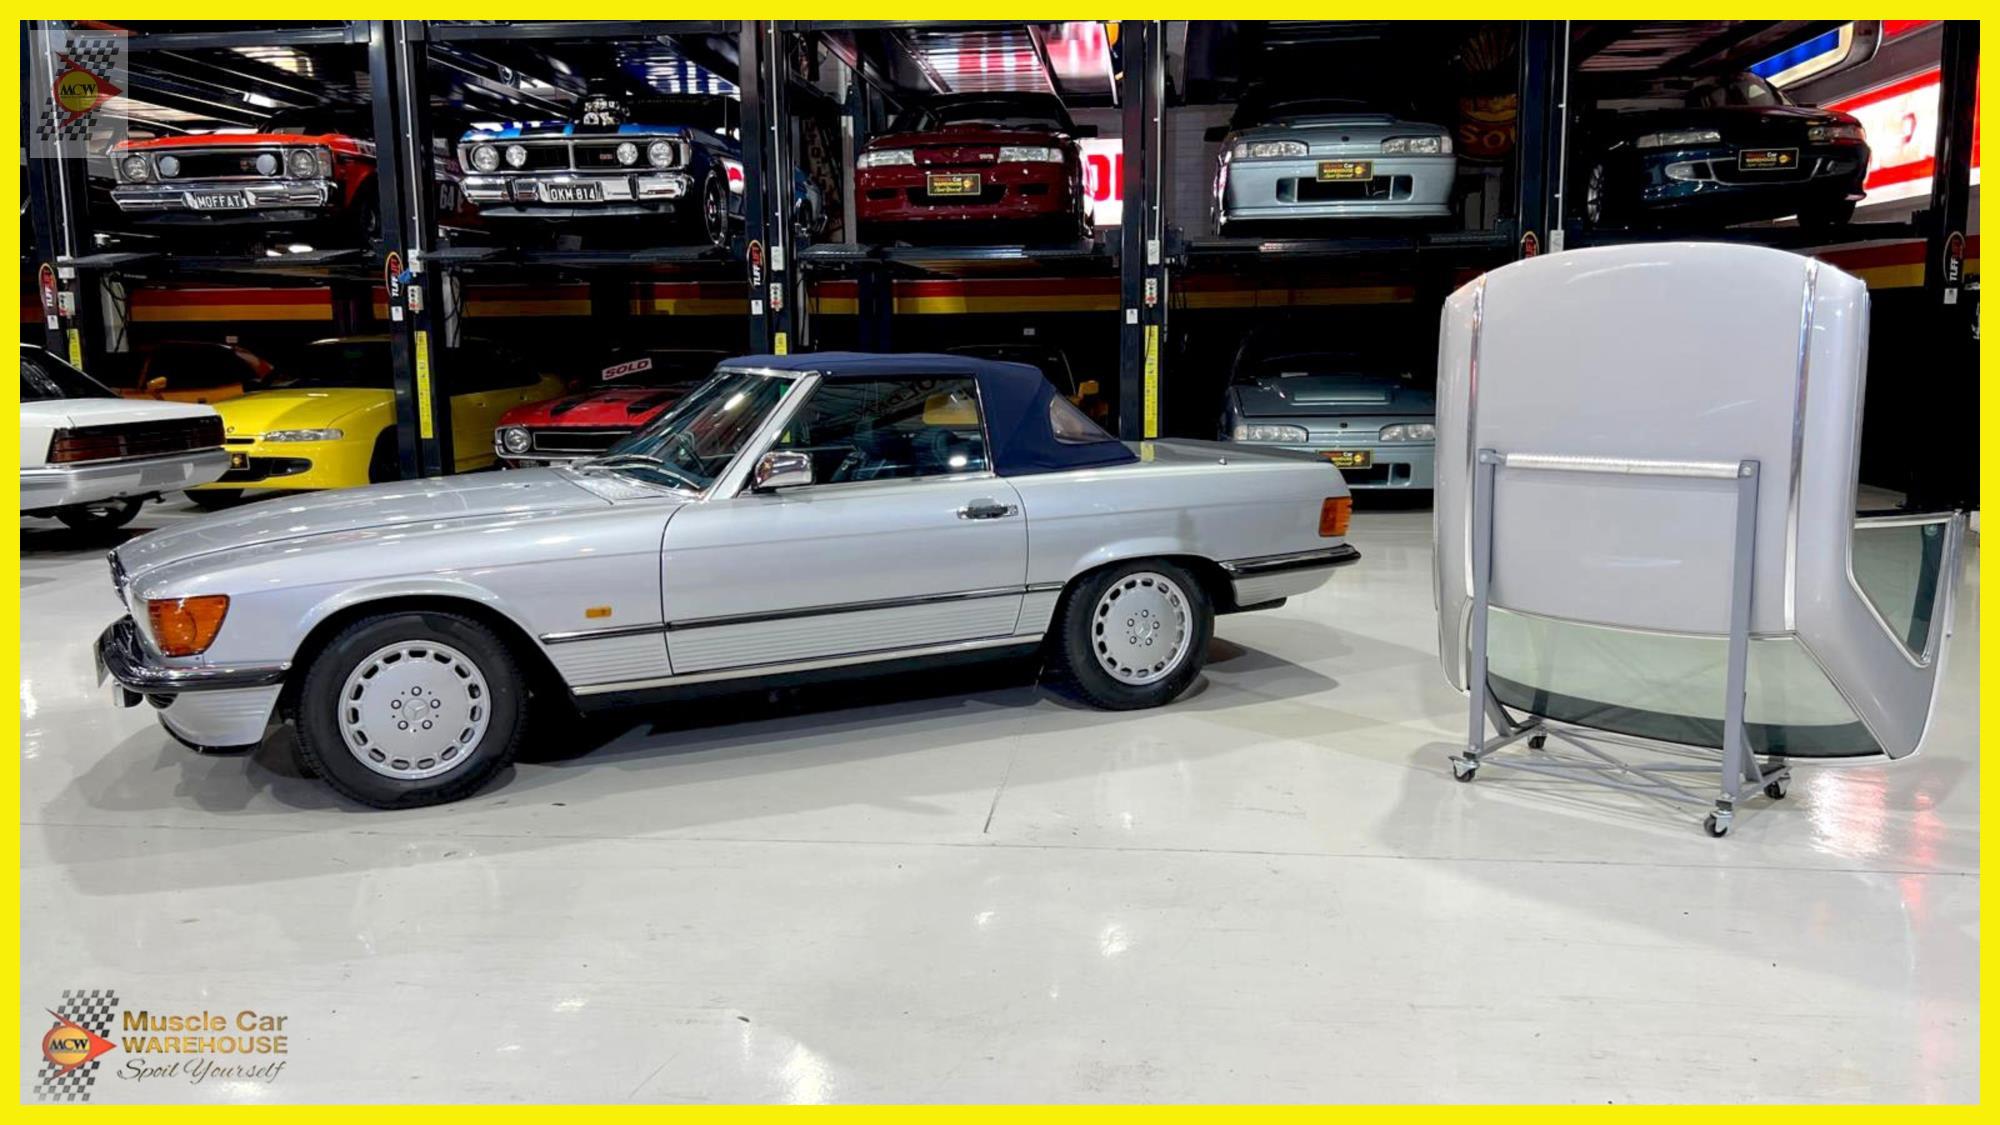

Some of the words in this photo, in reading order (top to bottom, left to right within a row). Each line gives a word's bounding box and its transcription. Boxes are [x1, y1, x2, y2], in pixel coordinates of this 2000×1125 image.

[576, 187, 596, 200] 814
[197, 195, 240, 207] MOFFAT
[604, 360, 649, 378] SOLD
